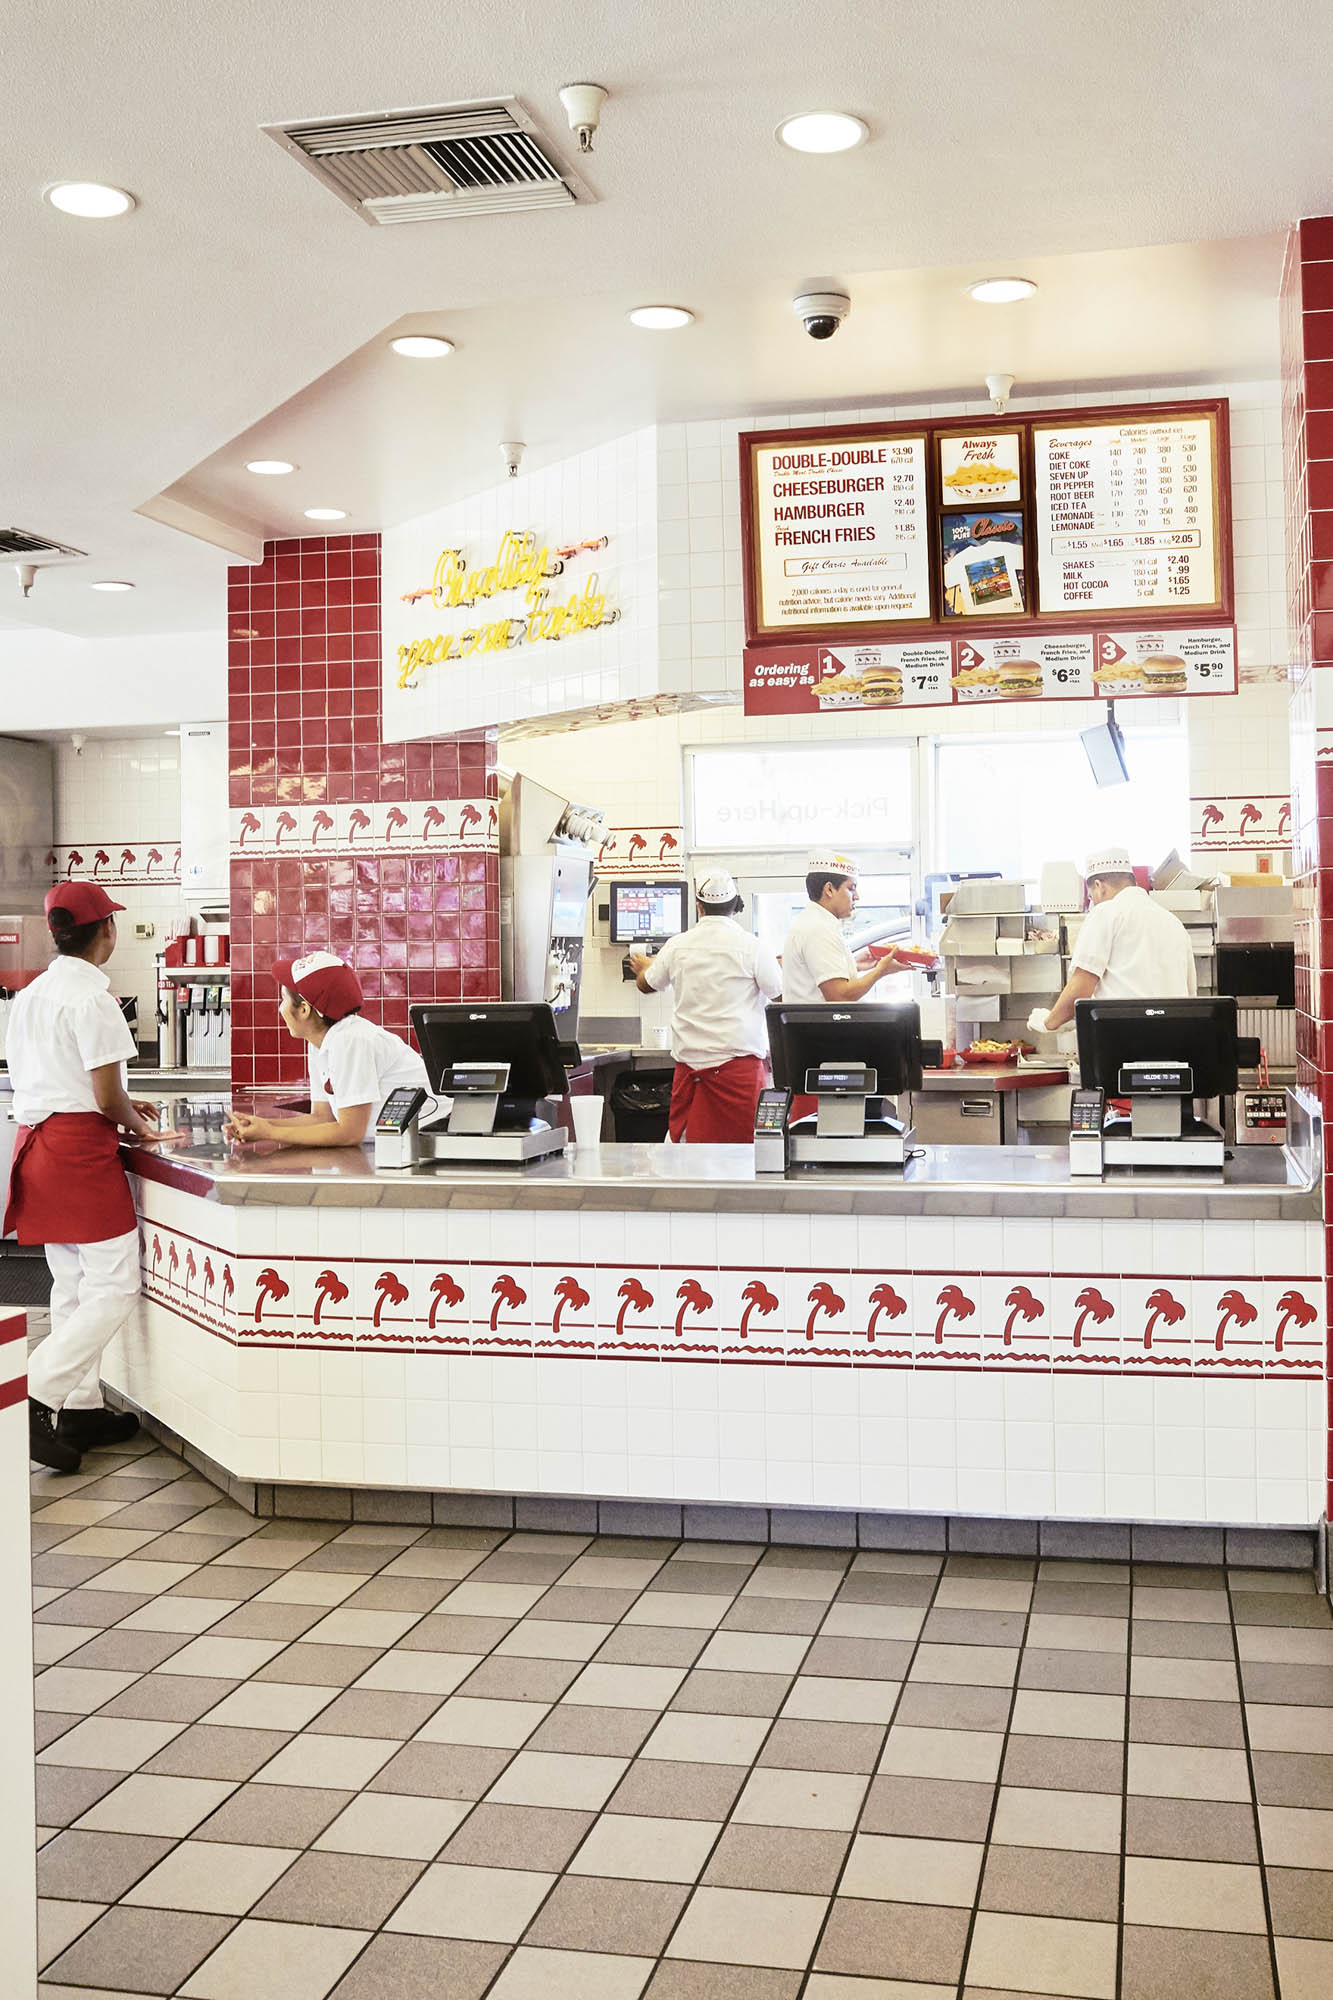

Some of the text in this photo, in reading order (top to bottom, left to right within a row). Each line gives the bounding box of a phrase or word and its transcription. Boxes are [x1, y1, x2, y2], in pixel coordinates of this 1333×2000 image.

[1120, 428, 1148, 437] Calories
[962, 440, 997, 449] Always
[1049, 439, 1092, 450] Beverages
[773, 447, 912, 470] DOUBLE-DOUBLE $3.90
[964, 449, 995, 461] Fresh
[1049, 451, 1070, 460] COKE
[1050, 462, 1066, 470] DIET
[1070, 460, 1090, 469] COKE
[1050, 472, 1075, 480] SEVEN
[1078, 471, 1088, 479] UP
[773, 475, 914, 497] CHEESEBURGER $2.70
[1050, 483, 1061, 491] DR
[1064, 481, 1094, 490] PEPPER
[1050, 492, 1071, 501] ROOT
[1074, 491, 1094, 499] BEER
[774, 502, 864, 521] HAMBURGER
[1051, 502, 1068, 511] ICED
[1072, 502, 1086, 510] TEA
[1051, 512, 1094, 521] LEMONADE
[952, 526, 970, 535] 100%
[971, 517, 1016, 540] Classic
[1052, 521, 1095, 531] LEMONADE
[775, 529, 830, 546] FRENCH
[835, 527, 876, 541] FRIES
[953, 532, 970, 542] PURE
[1068, 541, 1087, 549] $1.55
[1104, 539, 1123, 547] $1.65
[1172, 535, 1192, 543] $2.05
[801, 558, 888, 574] Gift Cards Available
[1063, 561, 1094, 570] SHAKES
[1168, 555, 1189, 564] $2.40
[432, 531, 549, 609] Quality
[1063, 572, 1082, 580] MILK
[1082, 580, 1108, 589] COCOA
[1169, 576, 1189, 584] $1.65
[1064, 591, 1093, 600] COFFEE
[1169, 586, 1190, 595] $1.25
[1102, 641, 1117, 660] 3
[398, 635, 454, 689] you
[961, 648, 974, 667] 2
[755, 663, 809, 676] Ordering
[822, 656, 836, 674] 1
[750, 675, 815, 687] as easy as
